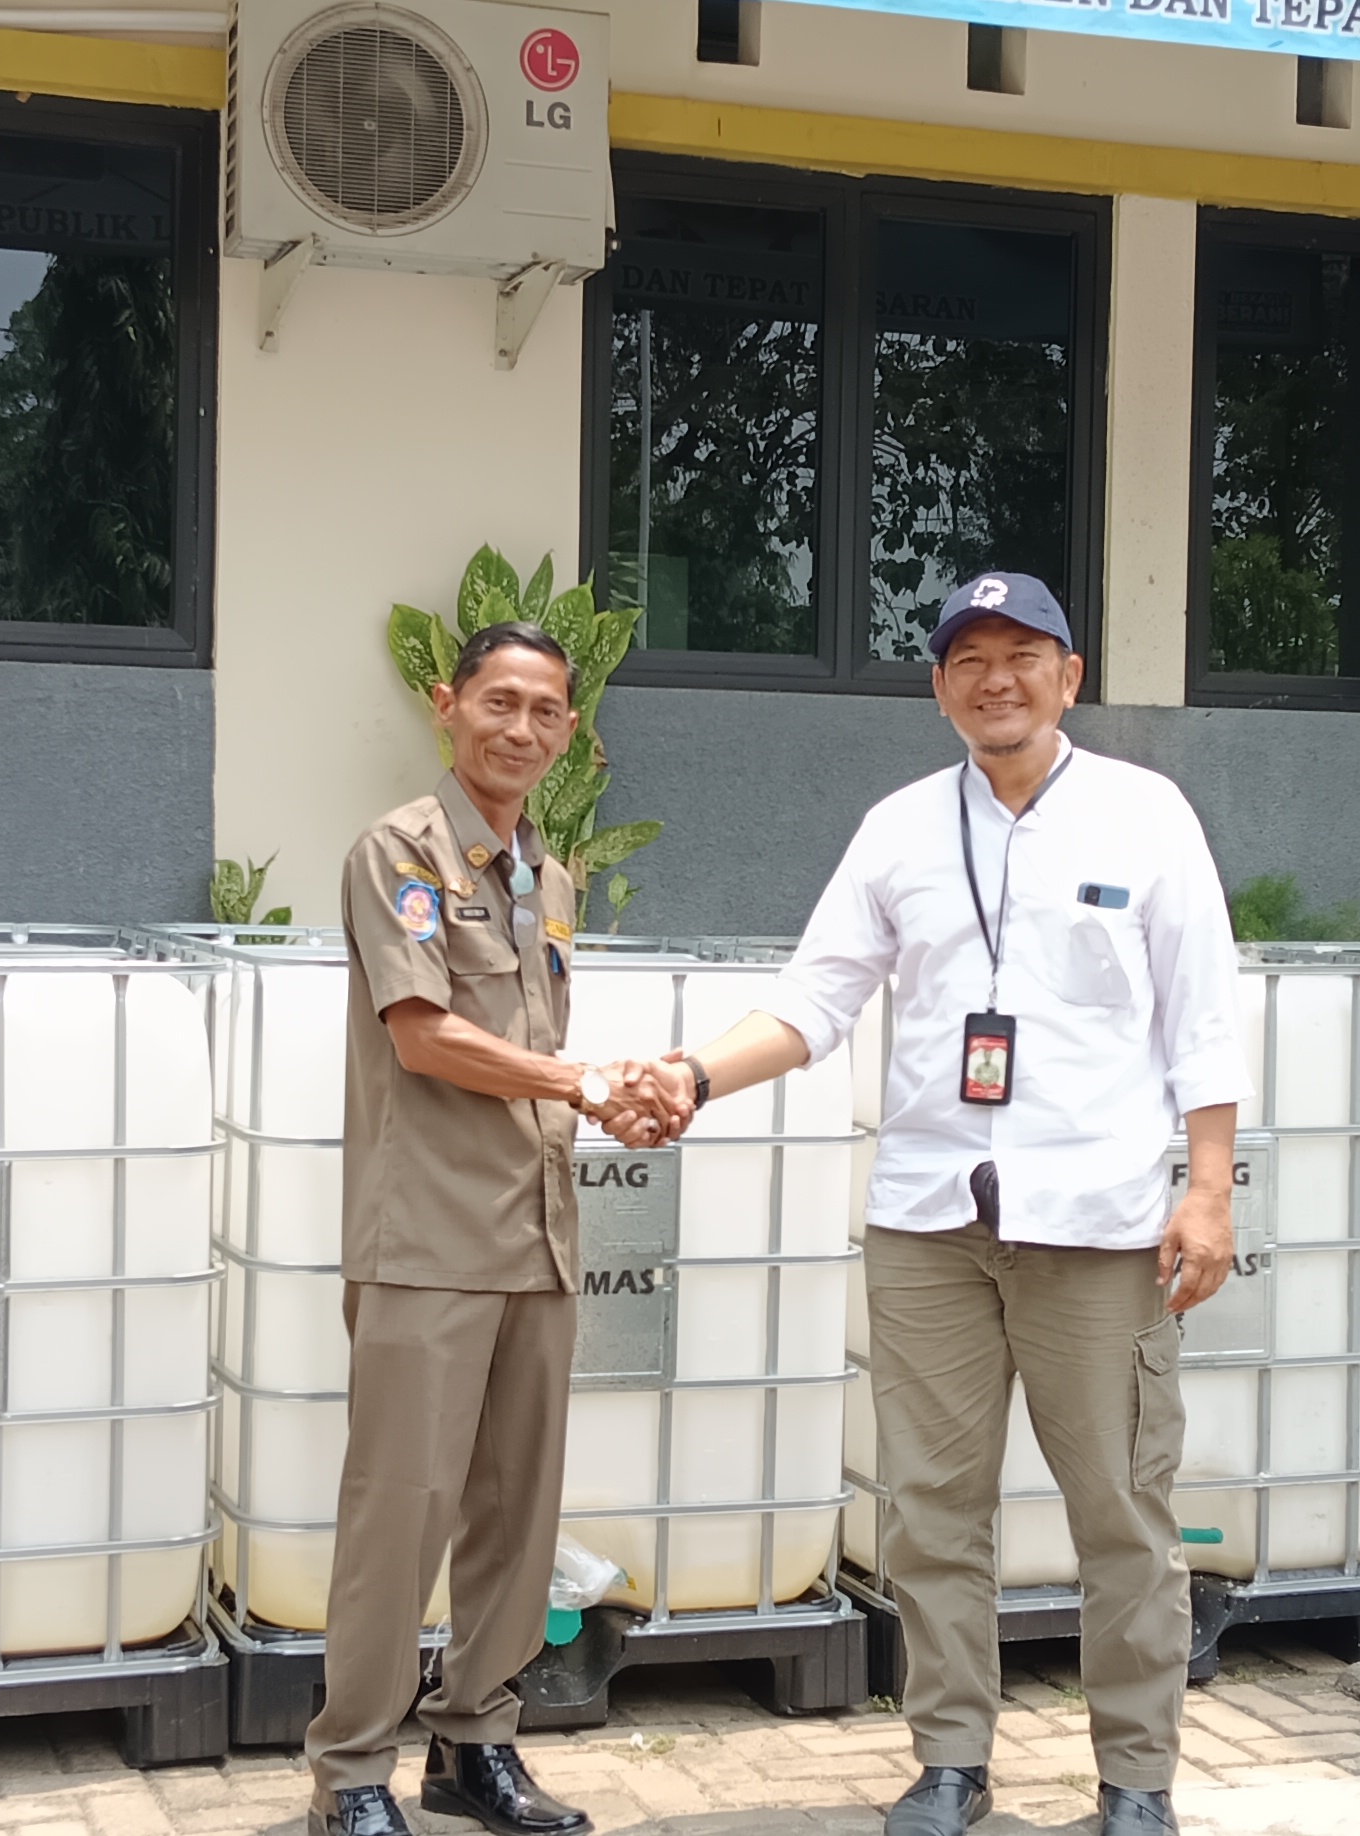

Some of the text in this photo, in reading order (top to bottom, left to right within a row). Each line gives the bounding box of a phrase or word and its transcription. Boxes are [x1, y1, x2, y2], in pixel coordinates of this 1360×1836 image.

[526, 99, 571, 130] LG
[621, 264, 692, 296] DAN
[703, 272, 810, 306] TEPAT
[571, 1162, 649, 1188] LAG
